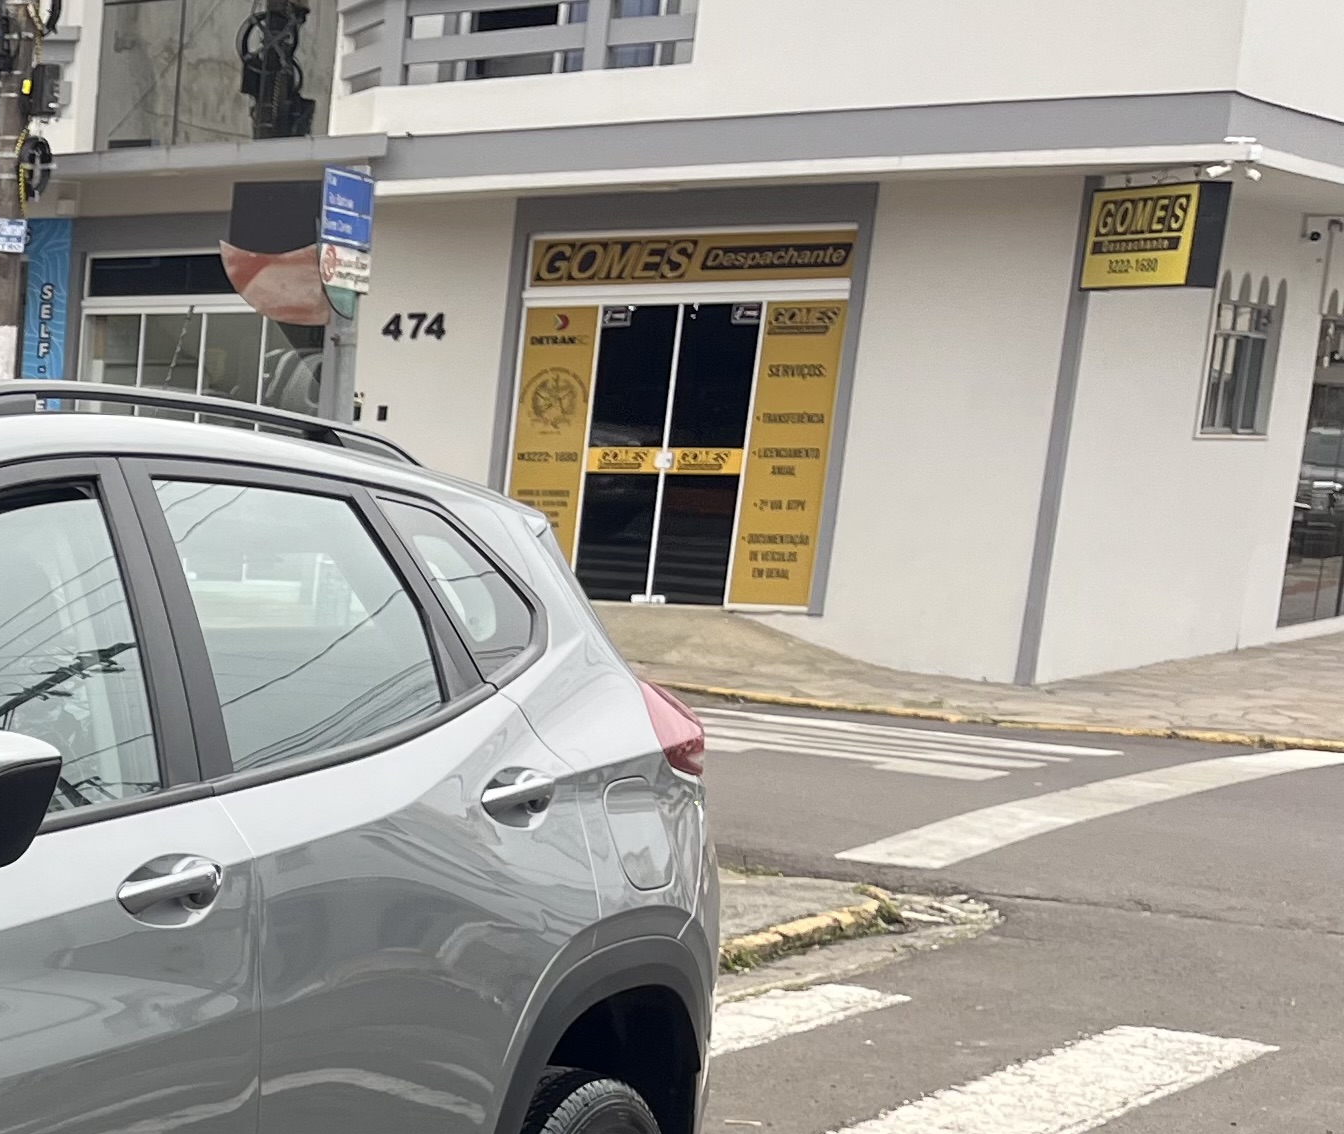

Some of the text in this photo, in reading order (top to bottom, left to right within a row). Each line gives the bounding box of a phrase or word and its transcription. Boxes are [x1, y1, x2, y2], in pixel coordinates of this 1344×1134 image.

[1098, 196, 1189, 235] GOMES
[536, 239, 846, 281] GOMES Despachante
[382, 312, 446, 340] 474
